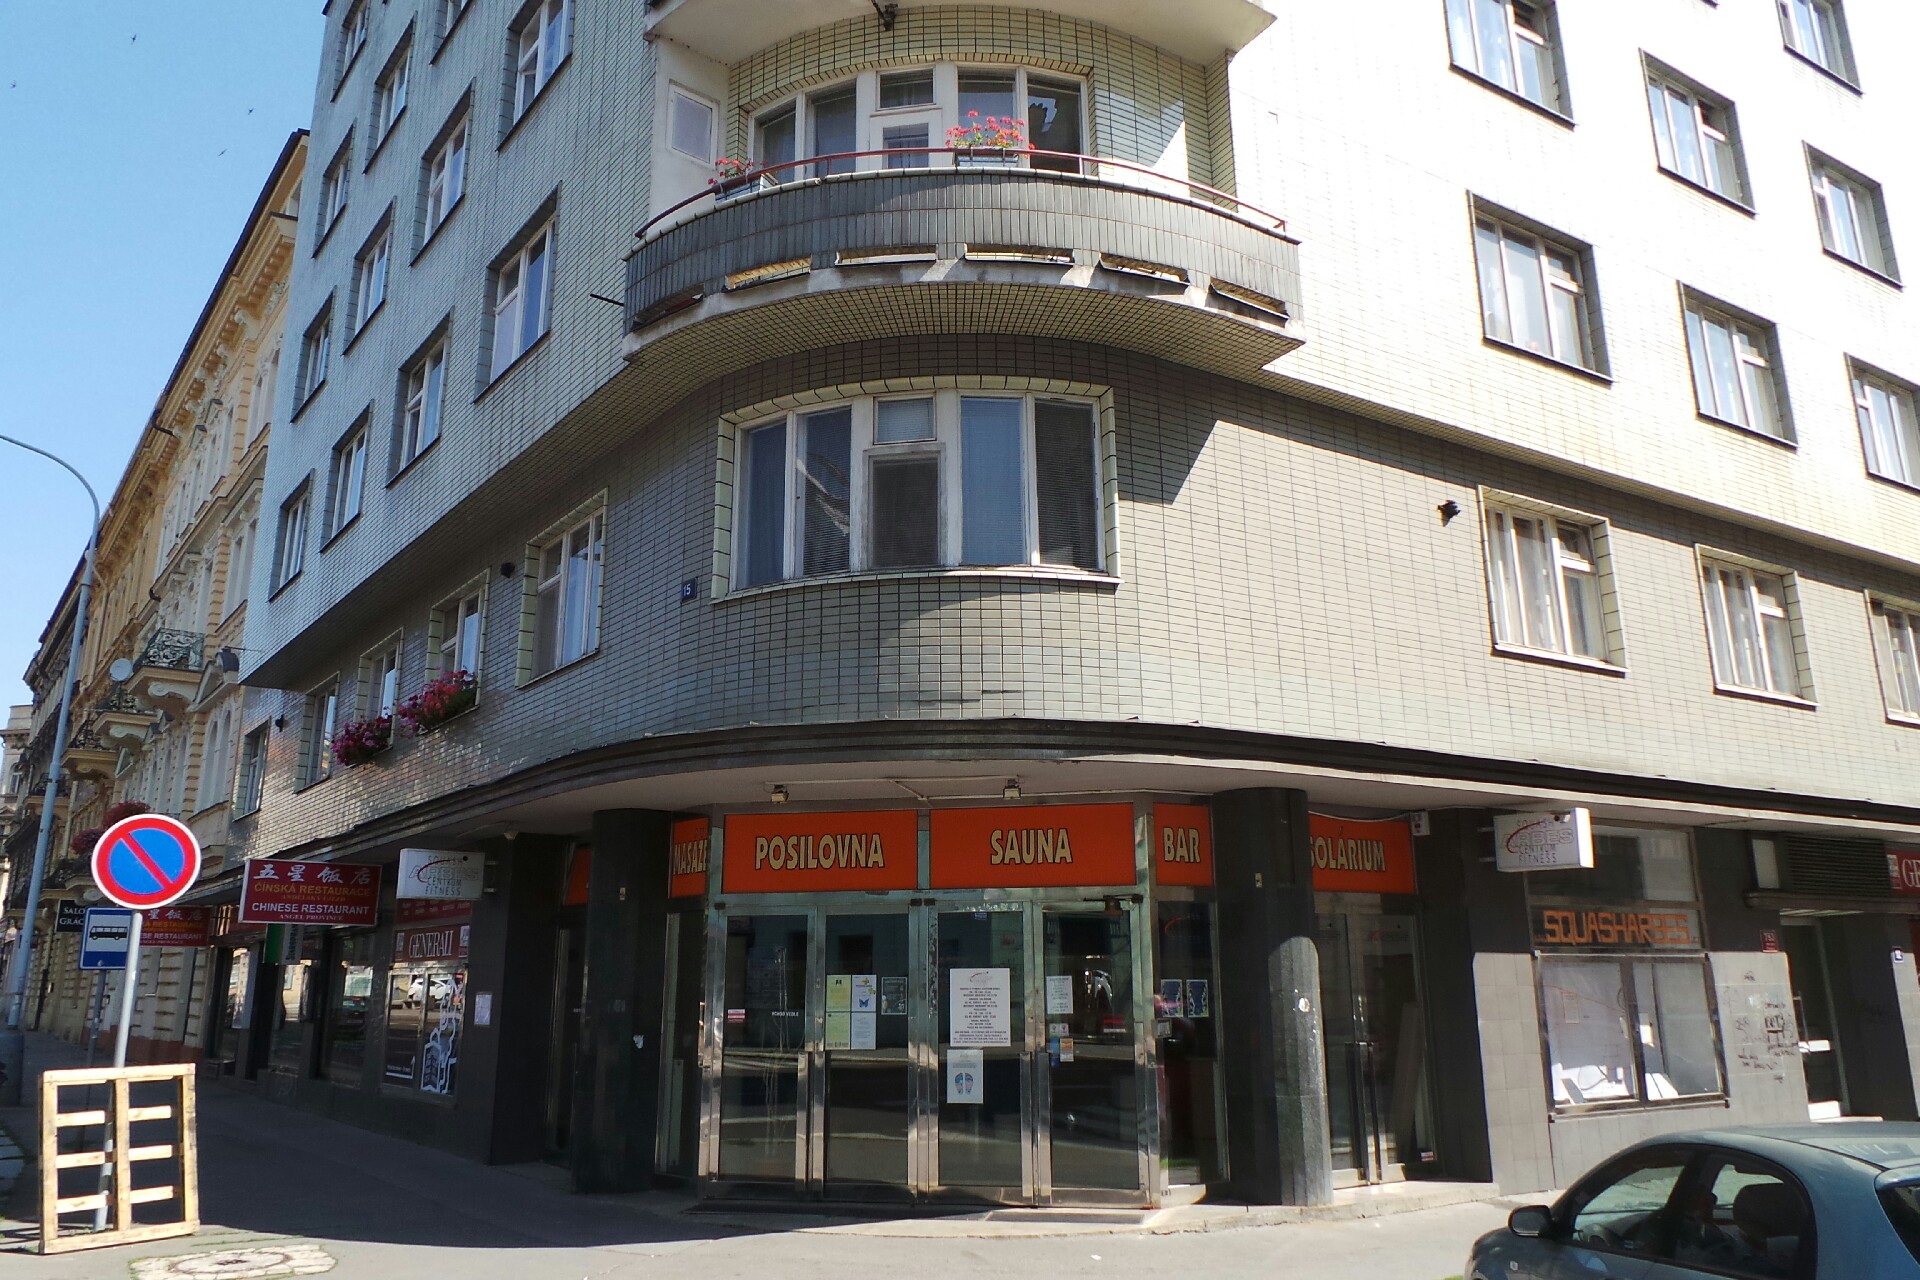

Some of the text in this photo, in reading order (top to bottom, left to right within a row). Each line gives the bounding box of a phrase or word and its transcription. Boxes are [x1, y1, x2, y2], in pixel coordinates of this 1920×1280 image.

[990, 827, 1073, 865] SAUNA
[1162, 827, 1200, 863] BAR
[755, 834, 885, 870] POSILOVNA
[1519, 852, 1557, 864] FITNESS
[427, 877, 462, 887] CENTRUM
[299, 885, 371, 897] RESTAURACE
[425, 886, 461, 896] FITNESS
[63, 906, 86, 915] SALO
[251, 902, 370, 915] CHINESE RESTAURANT
[59, 917, 84, 925] GRÁC
[408, 930, 454, 959] GENERALI
